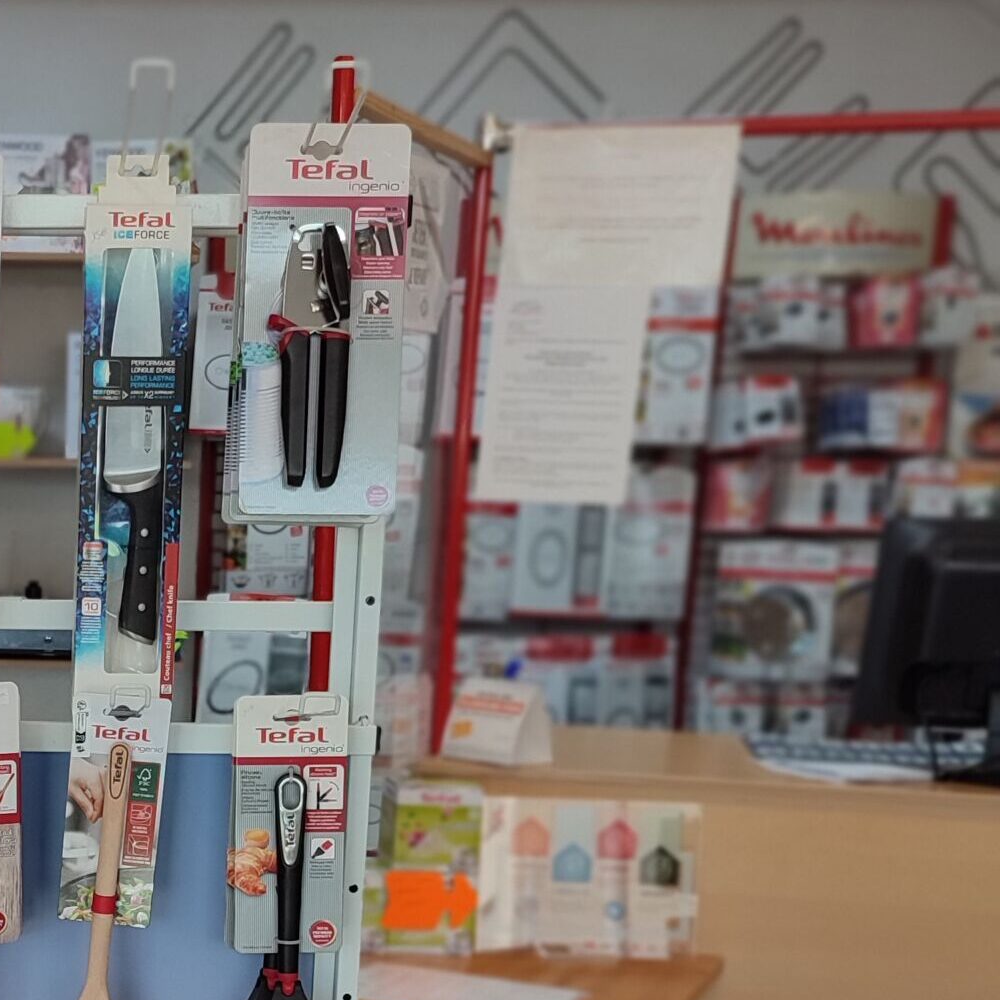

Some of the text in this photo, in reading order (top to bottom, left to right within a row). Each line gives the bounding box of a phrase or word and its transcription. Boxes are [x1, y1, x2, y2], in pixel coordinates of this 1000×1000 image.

[286, 159, 374, 180] Tefal
[349, 181, 400, 194] ingenio
[108, 211, 176, 228] Tefal
[113, 230, 170, 240] ICEFORCE
[85, 603, 99, 611] 10
[164, 633, 172, 649] chef
[162, 651, 171, 681] Couteau
[92, 724, 151, 742] Tefal
[255, 727, 329, 744] Tefal
[300, 745, 343, 755] ingenio
[113, 750, 124, 784] Tefal
